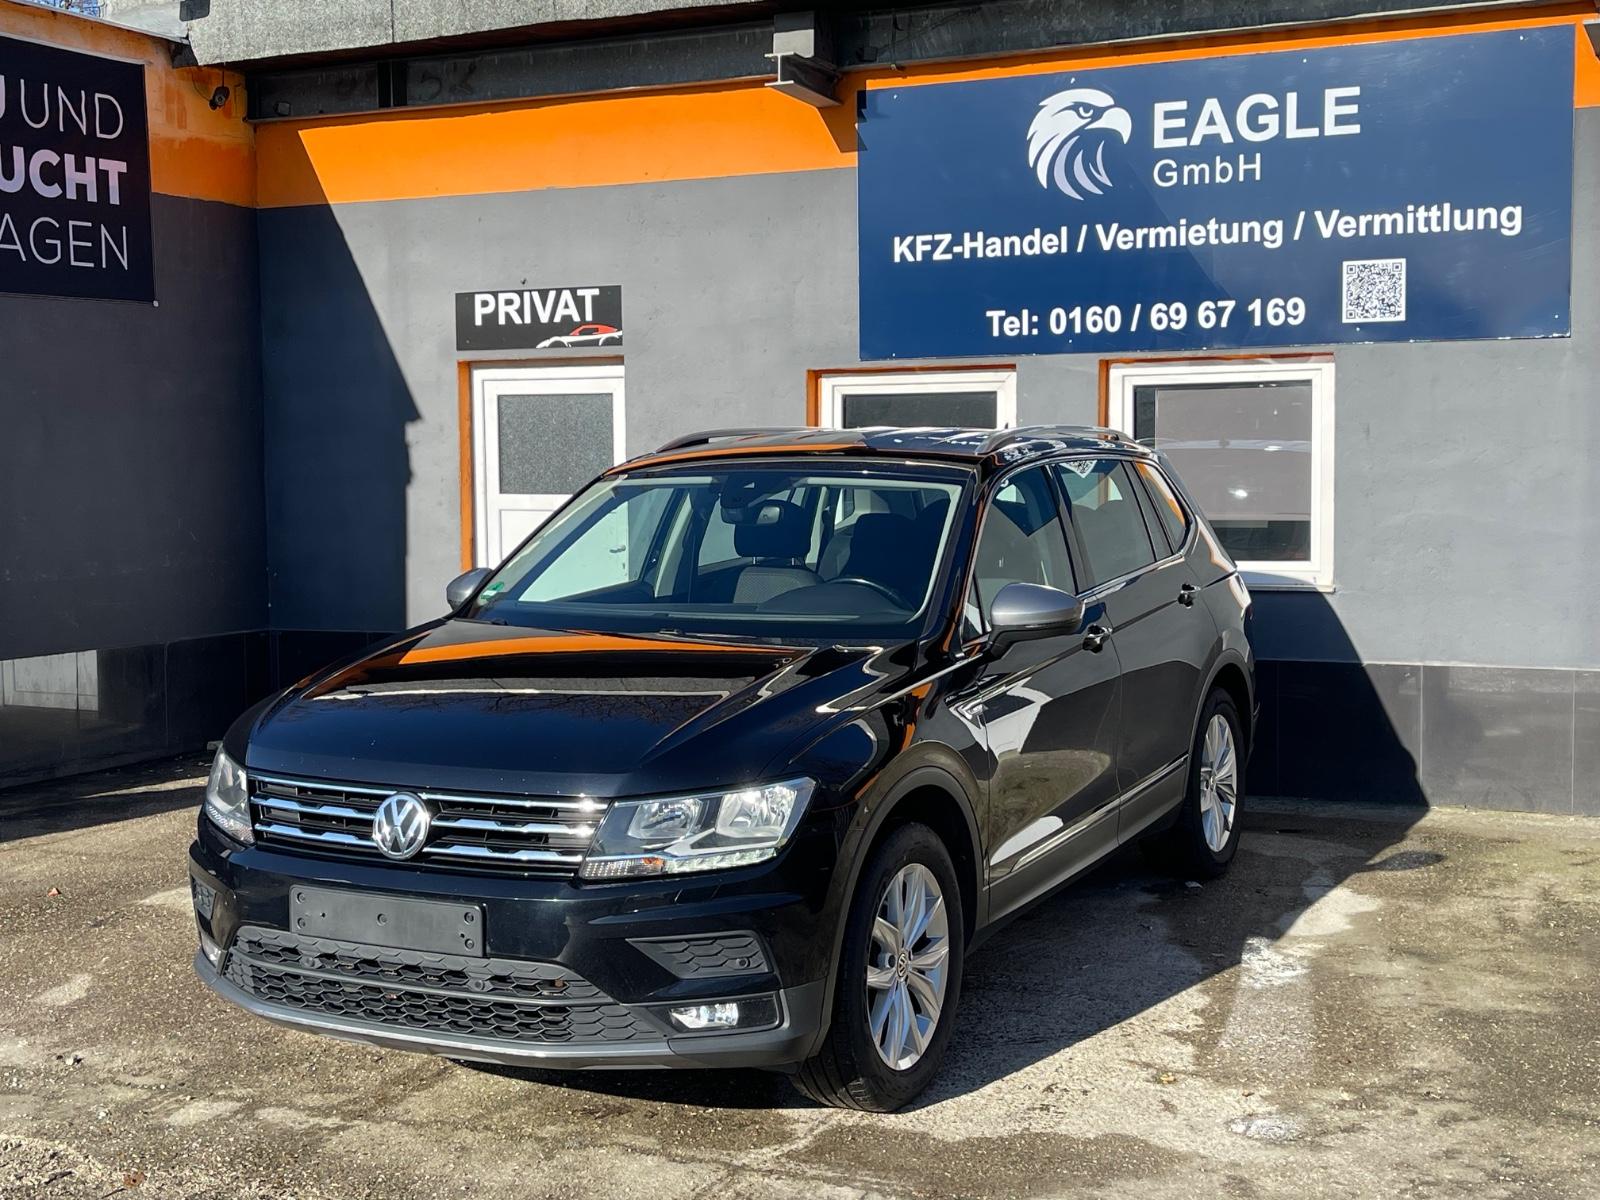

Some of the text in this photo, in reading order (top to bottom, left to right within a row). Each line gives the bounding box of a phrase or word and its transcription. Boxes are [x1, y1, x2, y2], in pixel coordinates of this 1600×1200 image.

[20, 78, 123, 140] UND
[1153, 85, 1362, 149] EAGLE
[0, 145, 128, 206] UCHT
[1153, 152, 1262, 188] GmbH
[0, 212, 128, 271] AGEN
[893, 203, 1523, 264] KFZ-Handel / Vermietung / Vermittlung
[473, 288, 600, 326] PRIVAT
[986, 297, 1306, 337] Tel: 0160 / 69 67 169
[373, 792, 429, 860] VW
